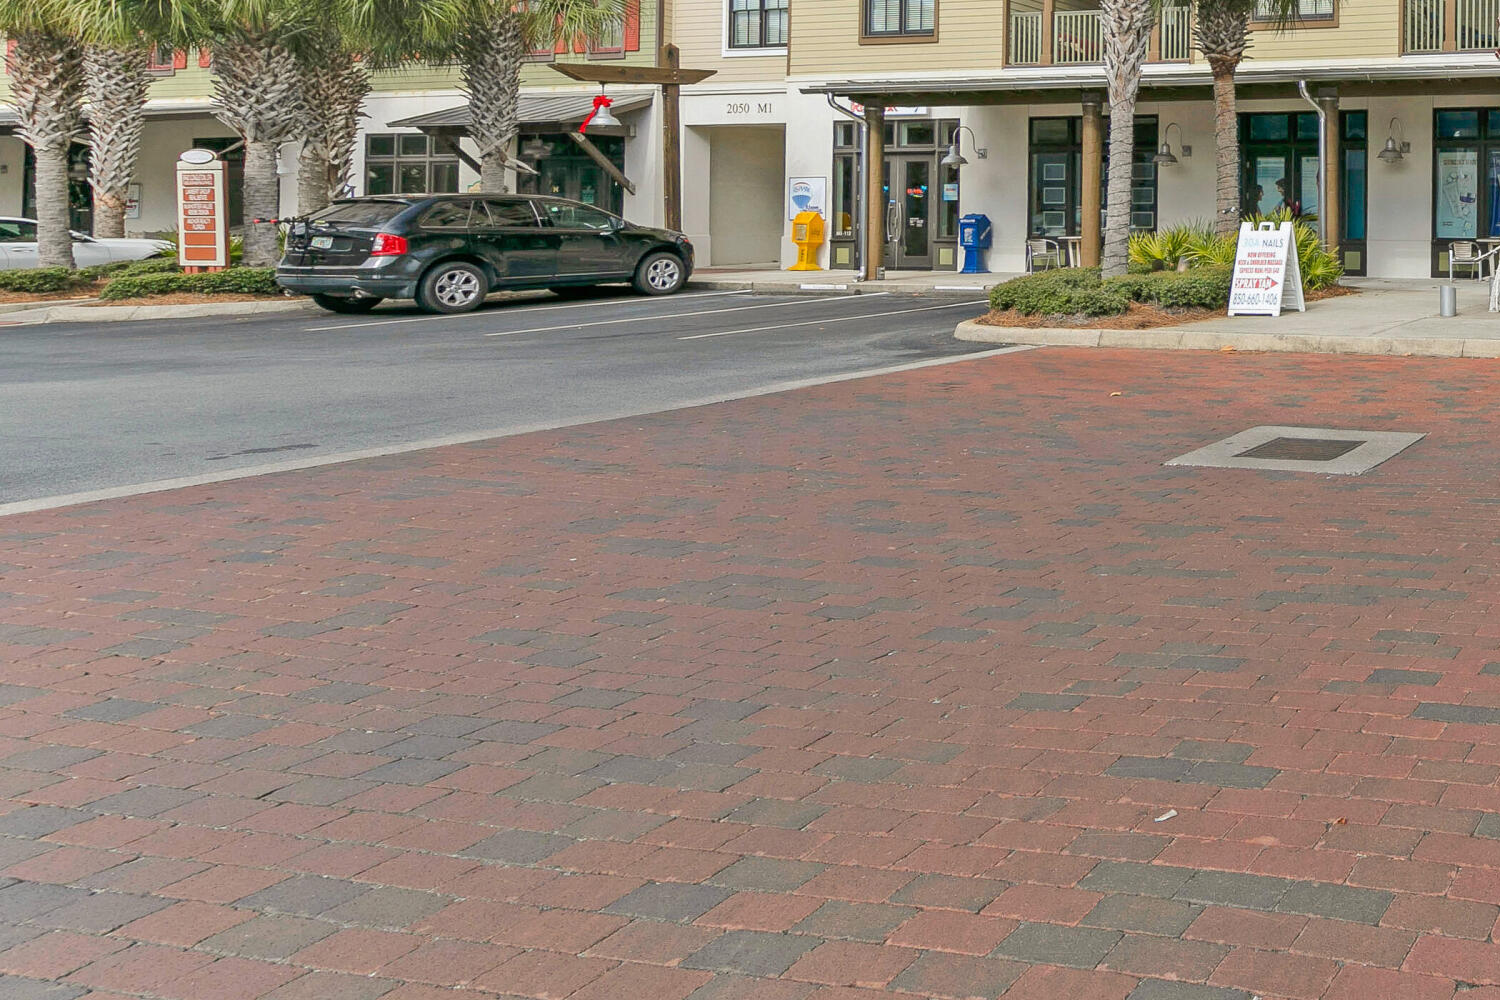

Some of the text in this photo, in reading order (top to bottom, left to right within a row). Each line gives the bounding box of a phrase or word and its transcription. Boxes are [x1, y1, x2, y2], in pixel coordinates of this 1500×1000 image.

[727, 103, 750, 114] 2050
[1262, 238, 1284, 248] NAILS
[1234, 278, 1272, 288] SPRAY TAN
